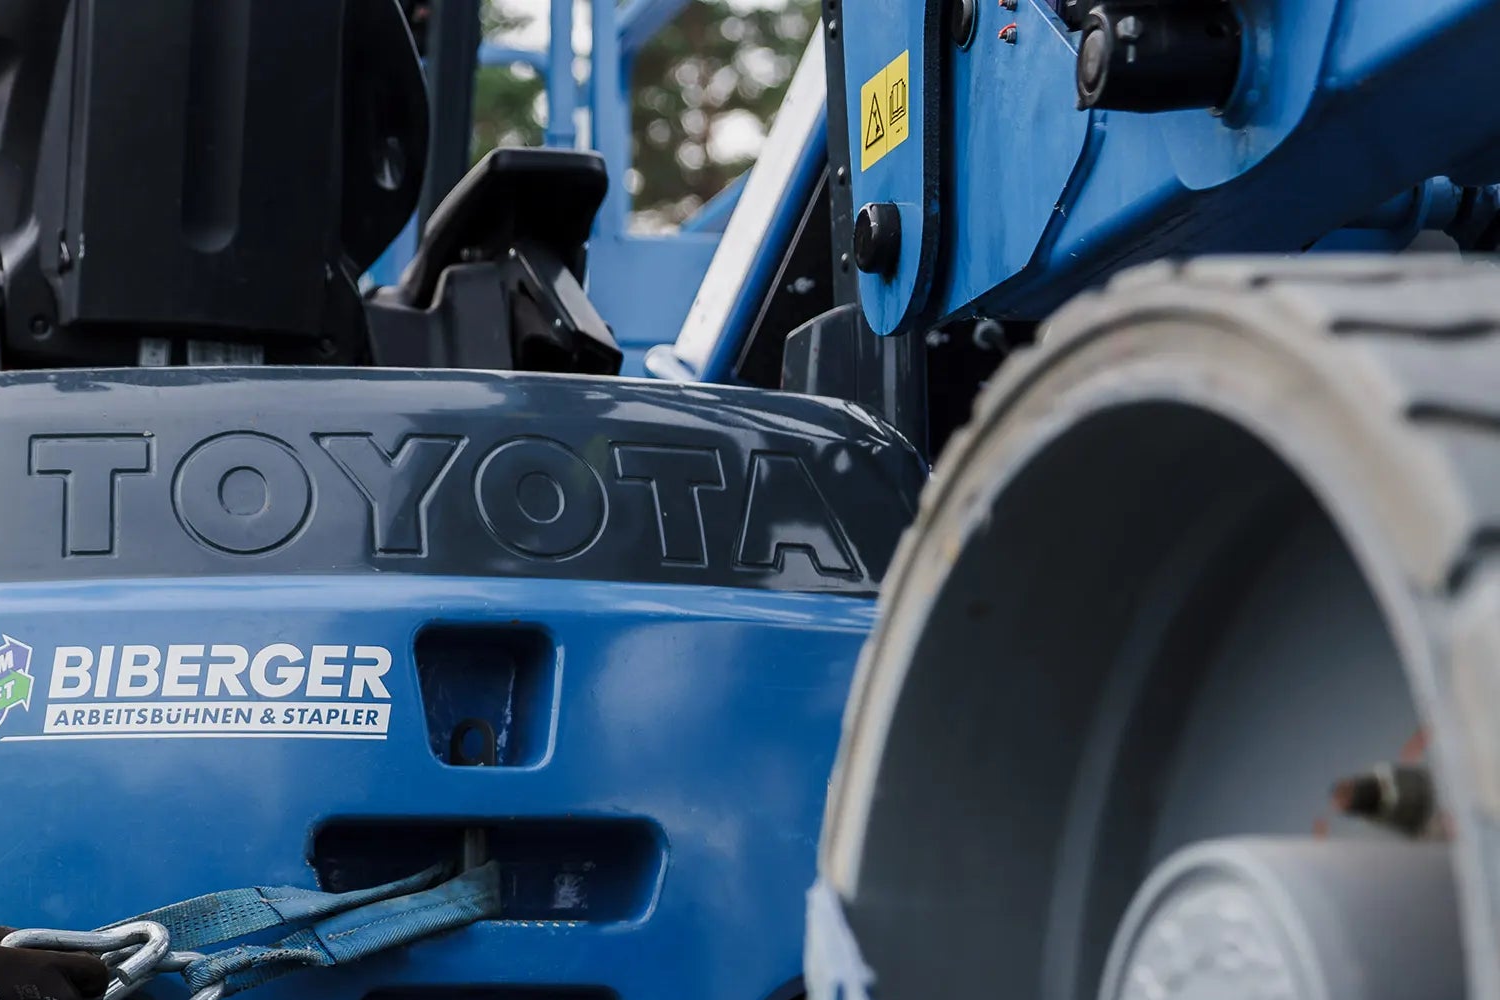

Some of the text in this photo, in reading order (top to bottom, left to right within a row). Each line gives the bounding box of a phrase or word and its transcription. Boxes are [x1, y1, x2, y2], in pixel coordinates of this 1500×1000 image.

[27, 429, 865, 581] TOYOTA
[48, 643, 392, 698] BIBERGER
[53, 707, 379, 726] ARBEITSBÜHNEN & STAPLER
